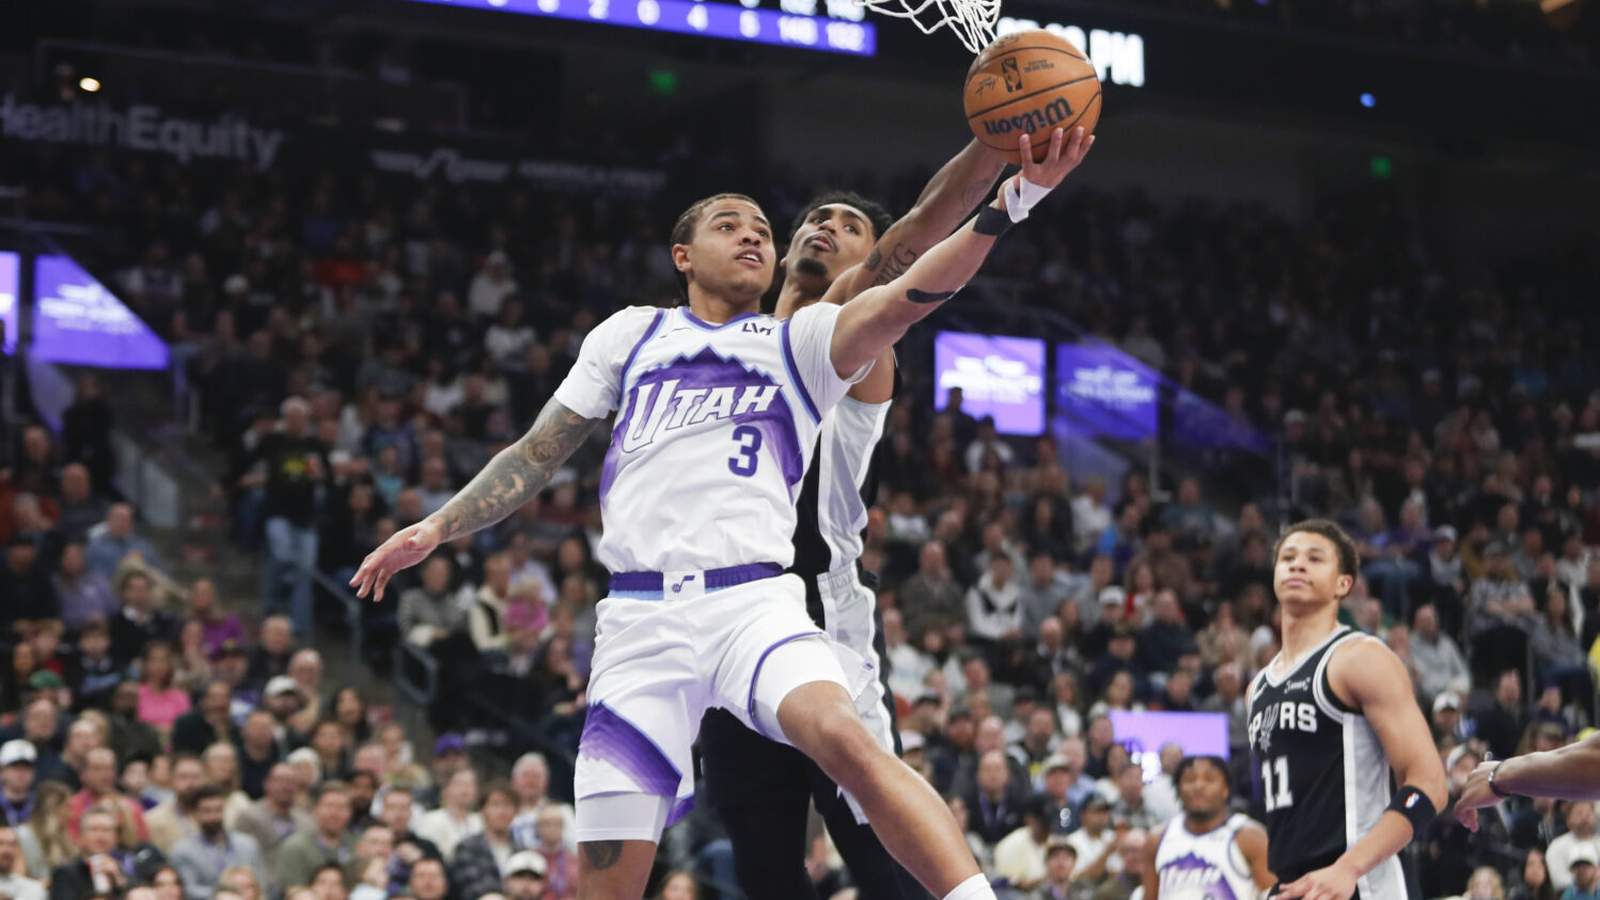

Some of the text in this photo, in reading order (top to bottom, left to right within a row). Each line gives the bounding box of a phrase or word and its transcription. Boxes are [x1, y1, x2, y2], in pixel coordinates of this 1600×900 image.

[982, 96, 1073, 134] Wilson
[729, 425, 761, 477] 3
[1261, 755, 1293, 813] 11
